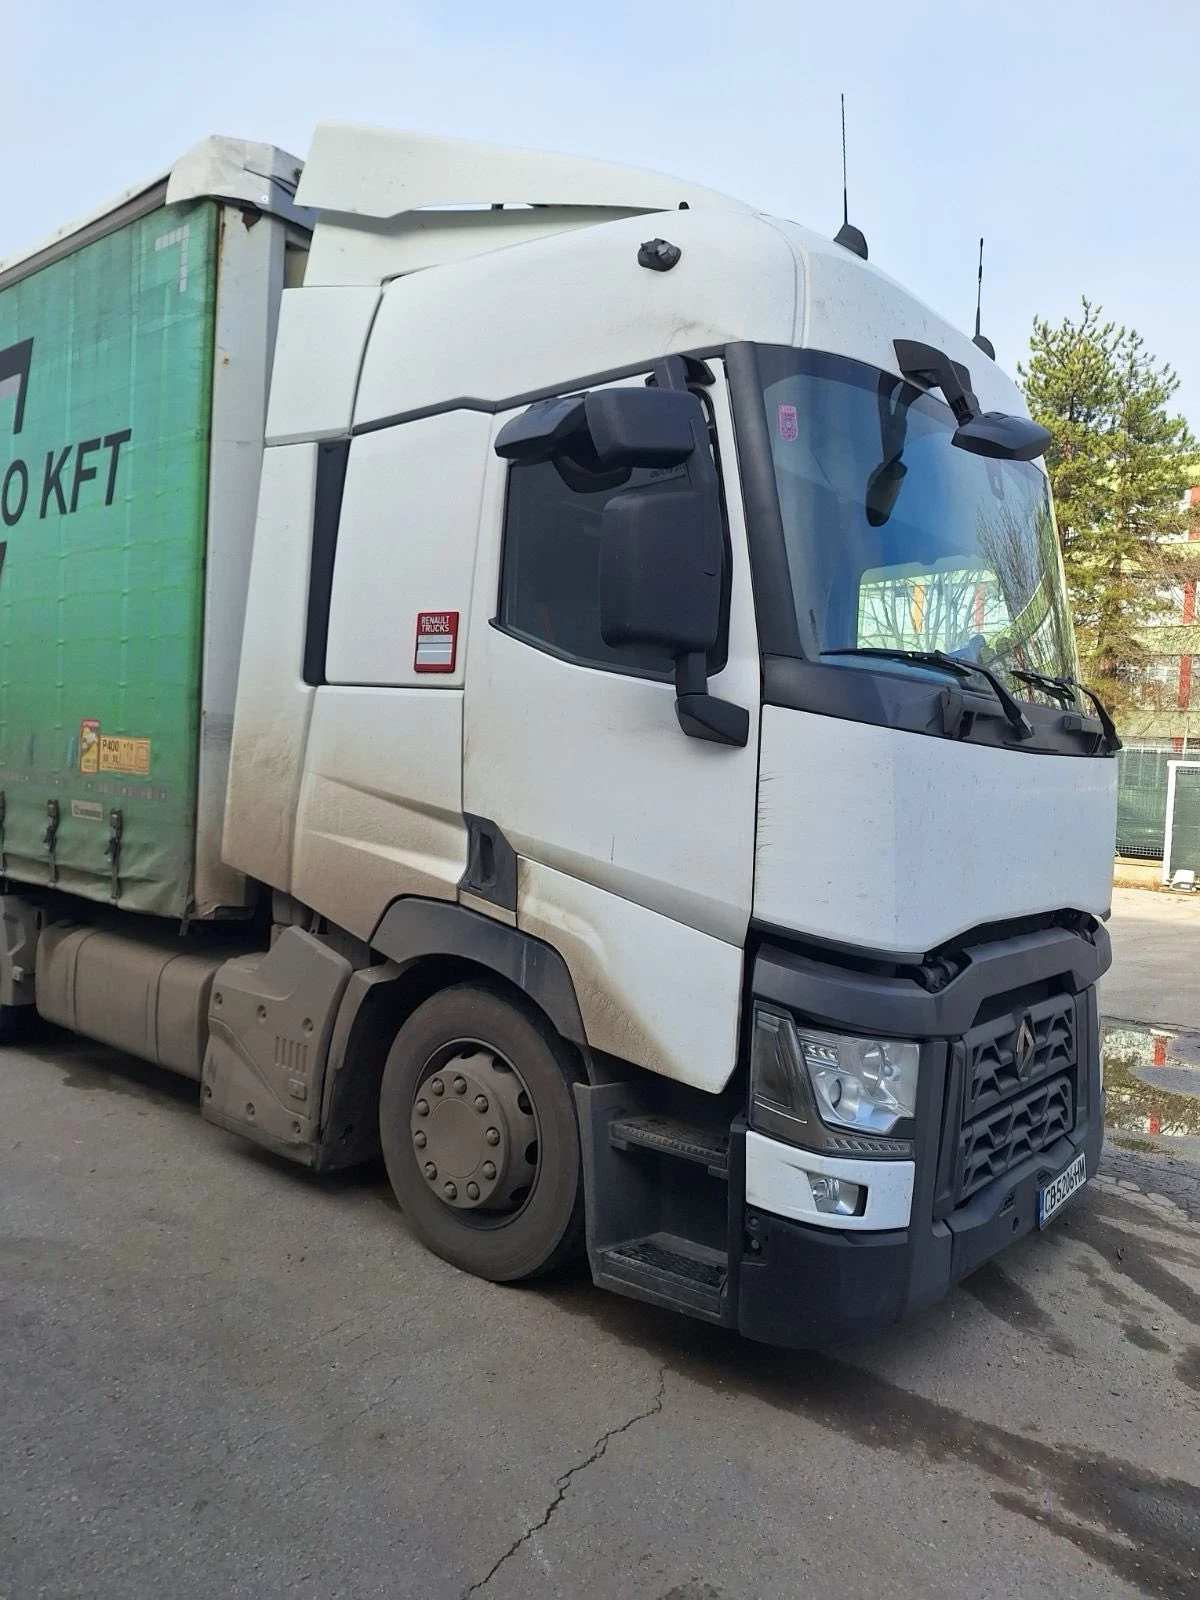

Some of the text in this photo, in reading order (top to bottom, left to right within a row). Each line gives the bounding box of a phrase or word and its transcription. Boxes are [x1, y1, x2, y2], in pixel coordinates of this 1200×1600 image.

[40, 428, 132, 519] KFT
[421, 616, 450, 625] RENAULT
[421, 624, 450, 633] TRUCKS
